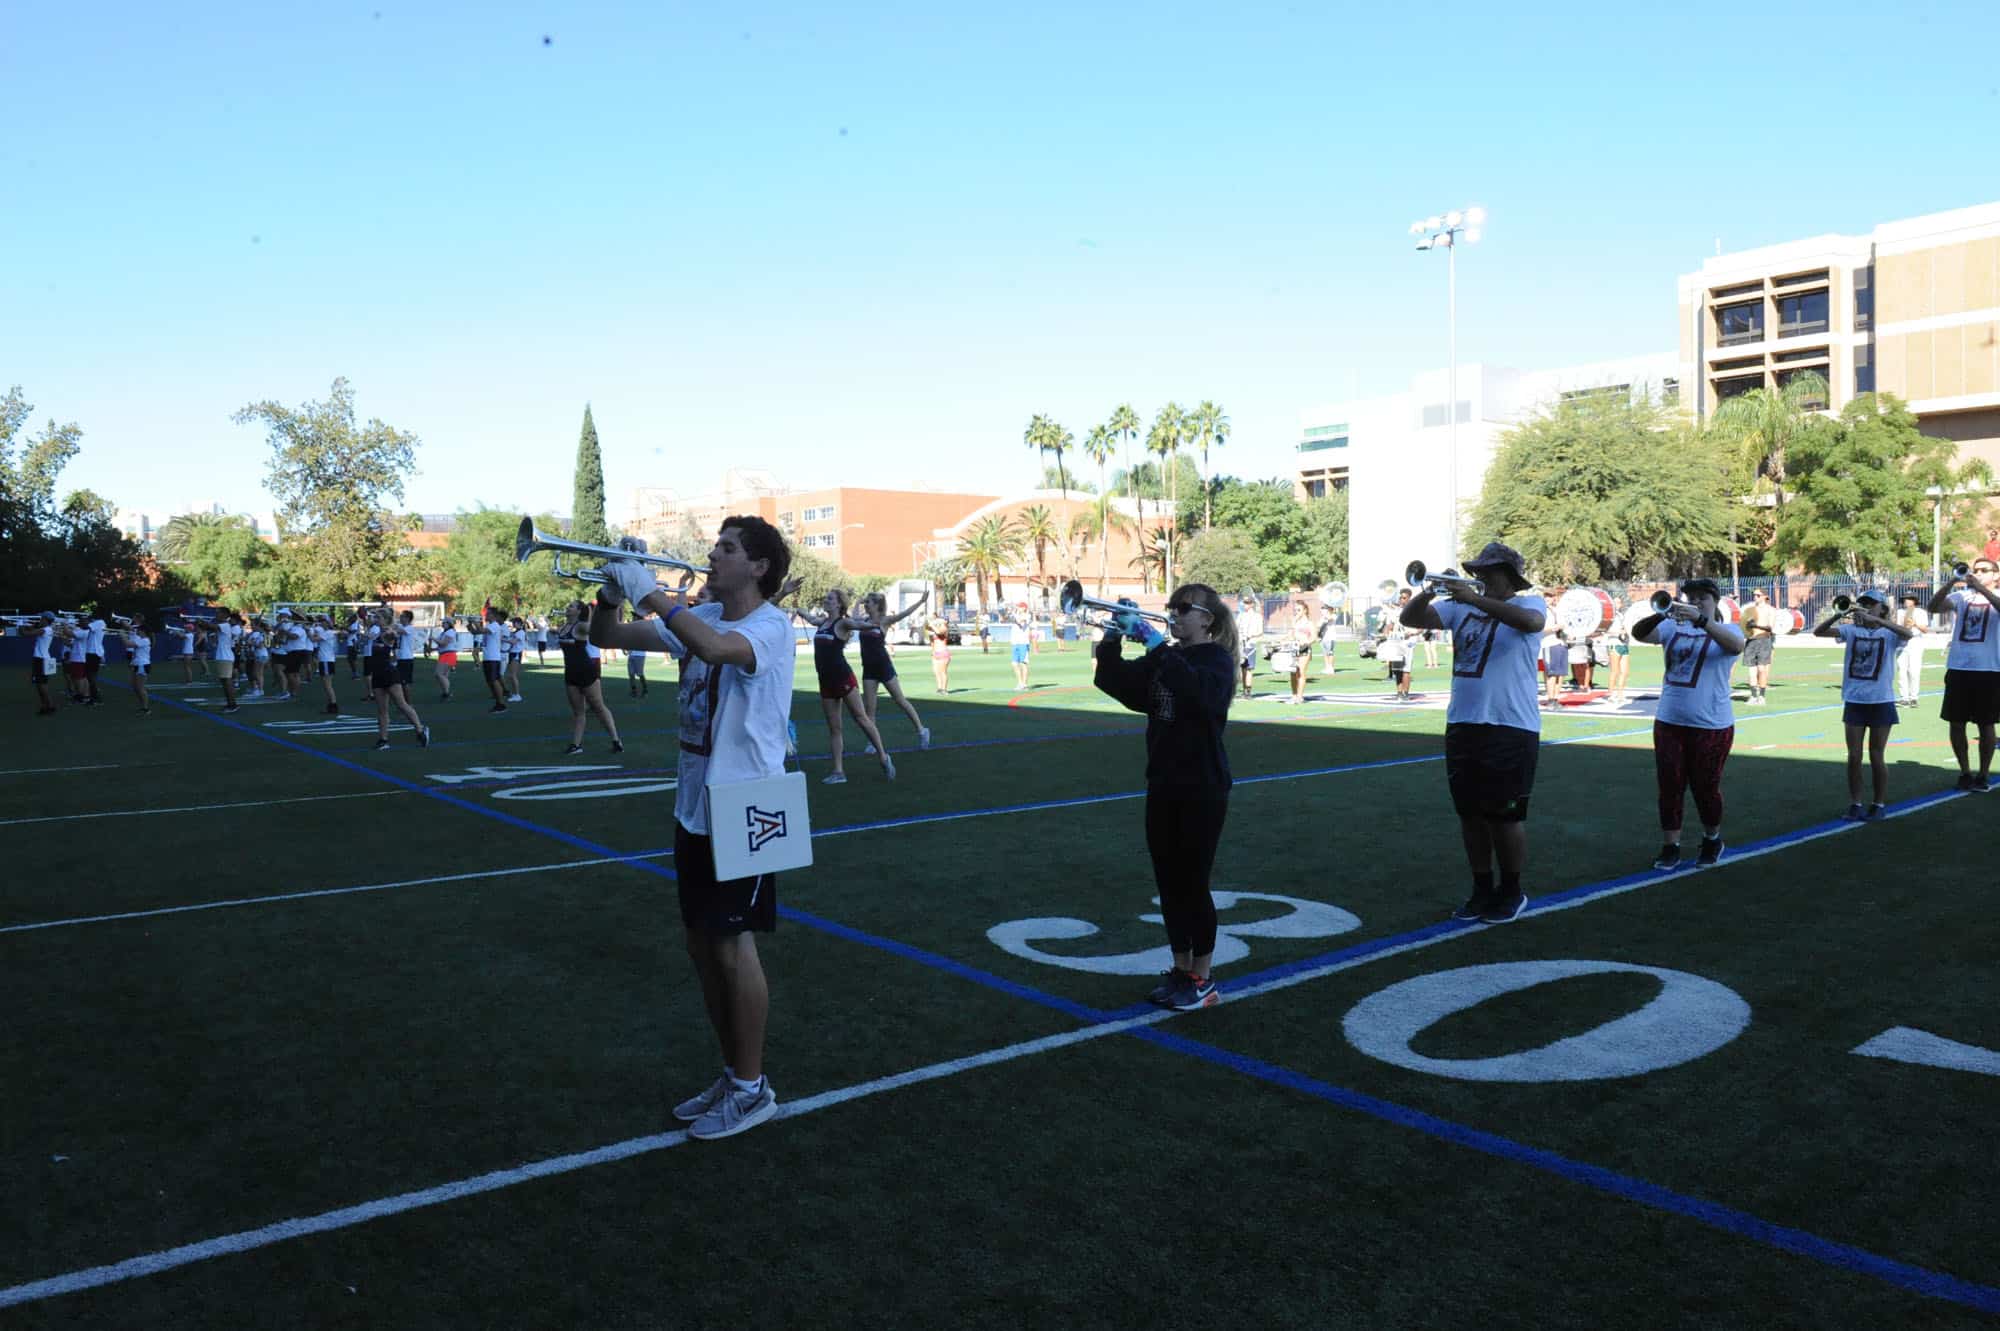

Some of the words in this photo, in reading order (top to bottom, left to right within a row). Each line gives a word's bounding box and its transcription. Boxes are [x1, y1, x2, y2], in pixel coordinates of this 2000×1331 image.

[424, 764, 679, 800] 40
[746, 806, 787, 851] A
[986, 890, 1752, 1083] 30
